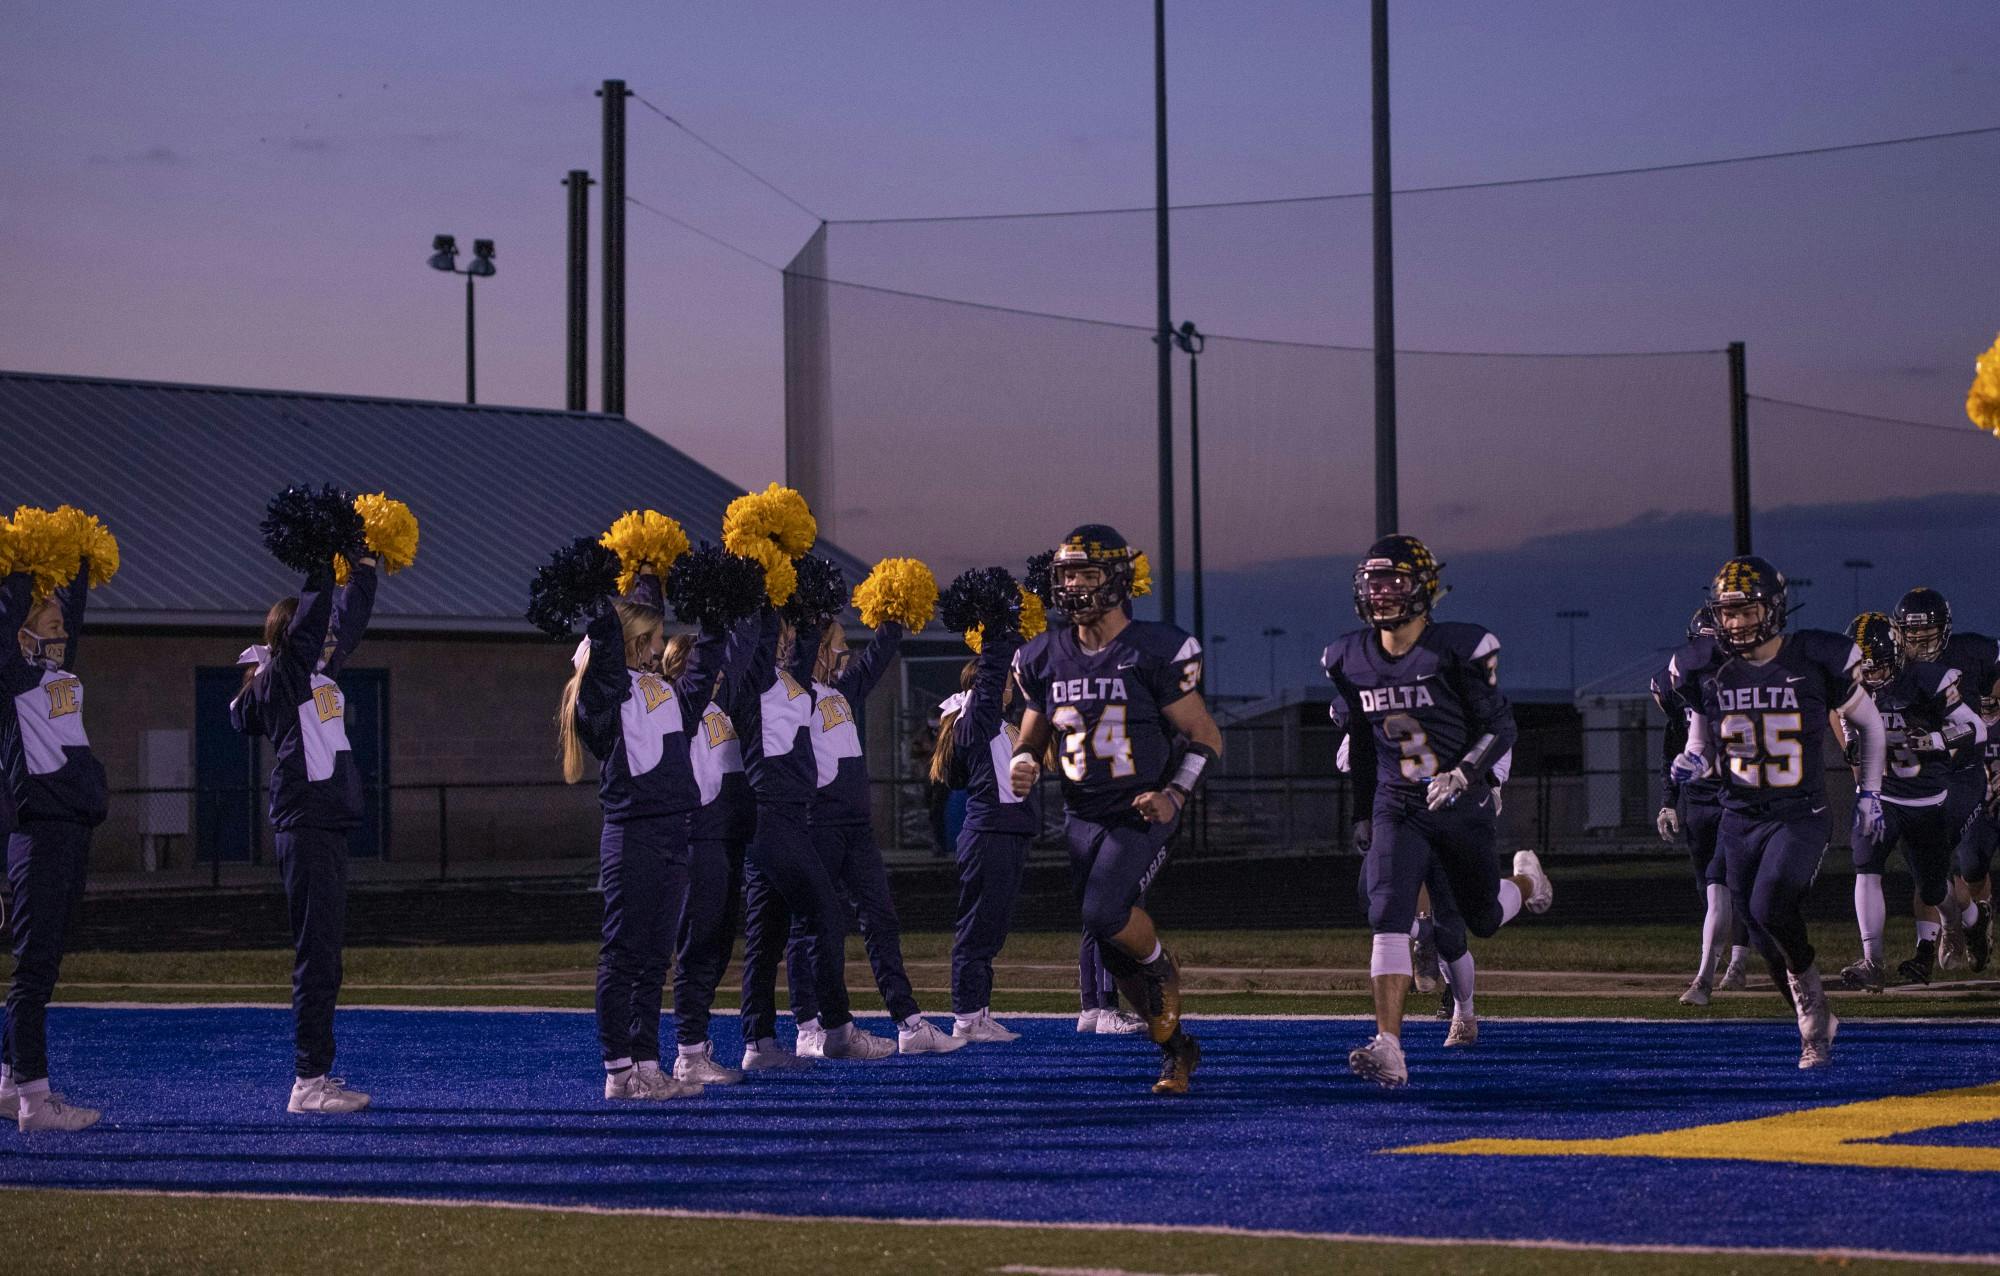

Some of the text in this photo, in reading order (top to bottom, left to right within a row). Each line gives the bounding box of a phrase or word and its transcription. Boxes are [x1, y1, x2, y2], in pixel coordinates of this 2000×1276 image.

[1051, 677, 1129, 703] DELTA
[1359, 685, 1434, 713] DELTA
[1717, 687, 1799, 711] DELTA
[1051, 704, 1137, 782] 34
[1383, 712, 1439, 784] 3
[1720, 712, 1804, 788] 25
